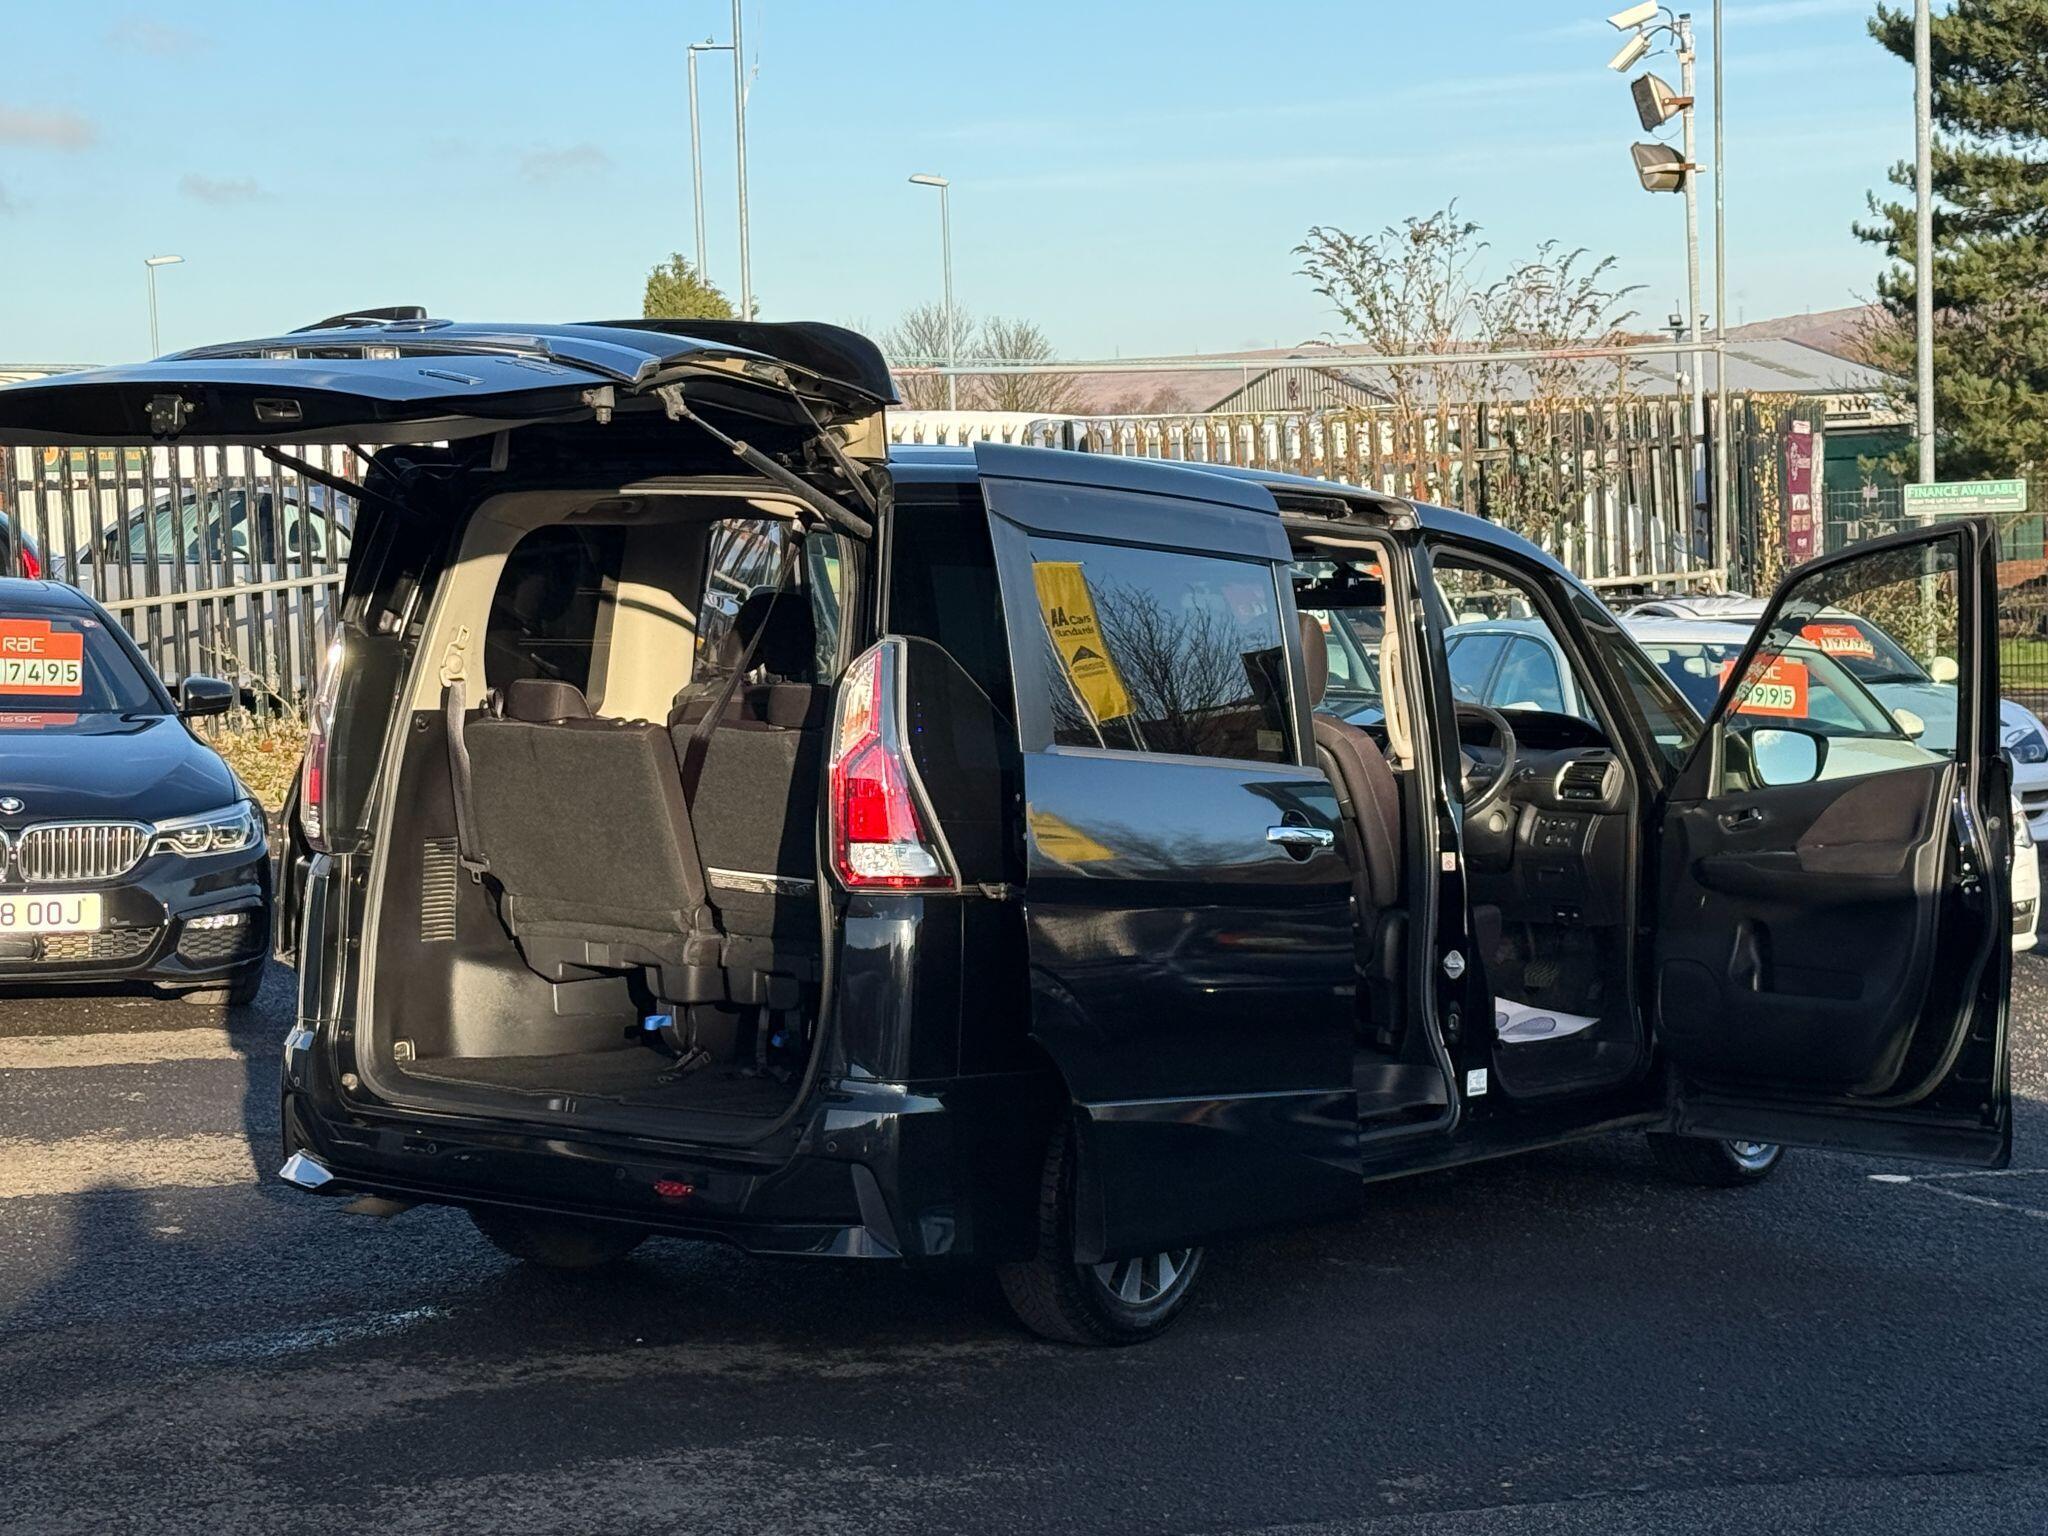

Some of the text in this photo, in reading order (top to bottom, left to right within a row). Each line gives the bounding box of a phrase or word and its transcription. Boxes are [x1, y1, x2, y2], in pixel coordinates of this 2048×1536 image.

[1907, 482, 2022, 498] FINANCE AVAILABLE
[9, 663, 78, 682] 7495
